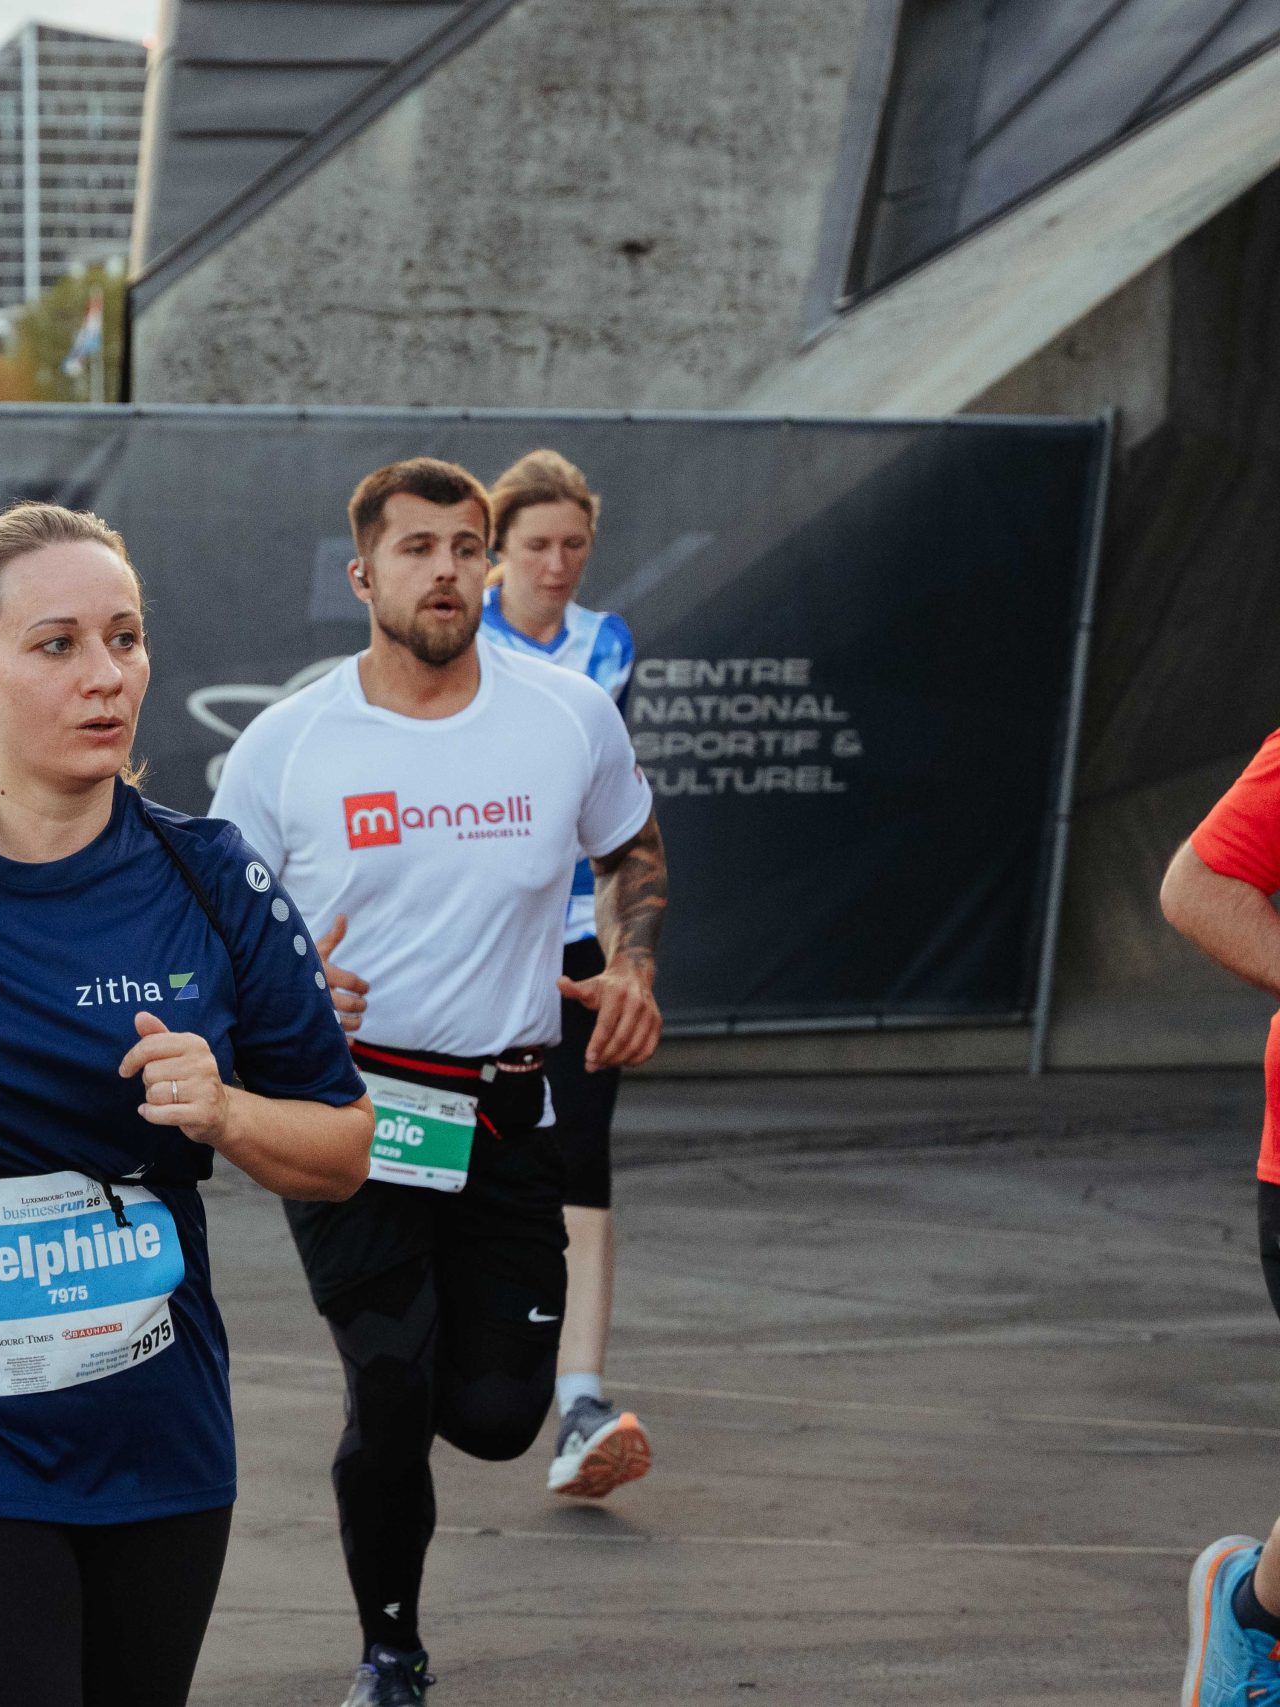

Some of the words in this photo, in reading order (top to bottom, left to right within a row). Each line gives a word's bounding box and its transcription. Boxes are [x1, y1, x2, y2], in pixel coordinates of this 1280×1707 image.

[634, 657, 813, 688] CENTRE
[632, 693, 851, 724] NATIONAL
[631, 729, 821, 760] SPORTIF
[832, 728, 863, 758] &
[349, 794, 533, 837] mannelli
[75, 975, 164, 1006] zitha
[374, 1115, 425, 1147] oïc
[21, 1193, 65, 1205] LUXEMBOURG
[65, 1189, 84, 1199] TIMES
[86, 1196, 101, 1208] 26
[48, 1285, 89, 1305] 7975
[25, 1333, 55, 1345] TIMES
[72, 1322, 123, 1339] BAUHAUS
[131, 1318, 171, 1361] 7975
